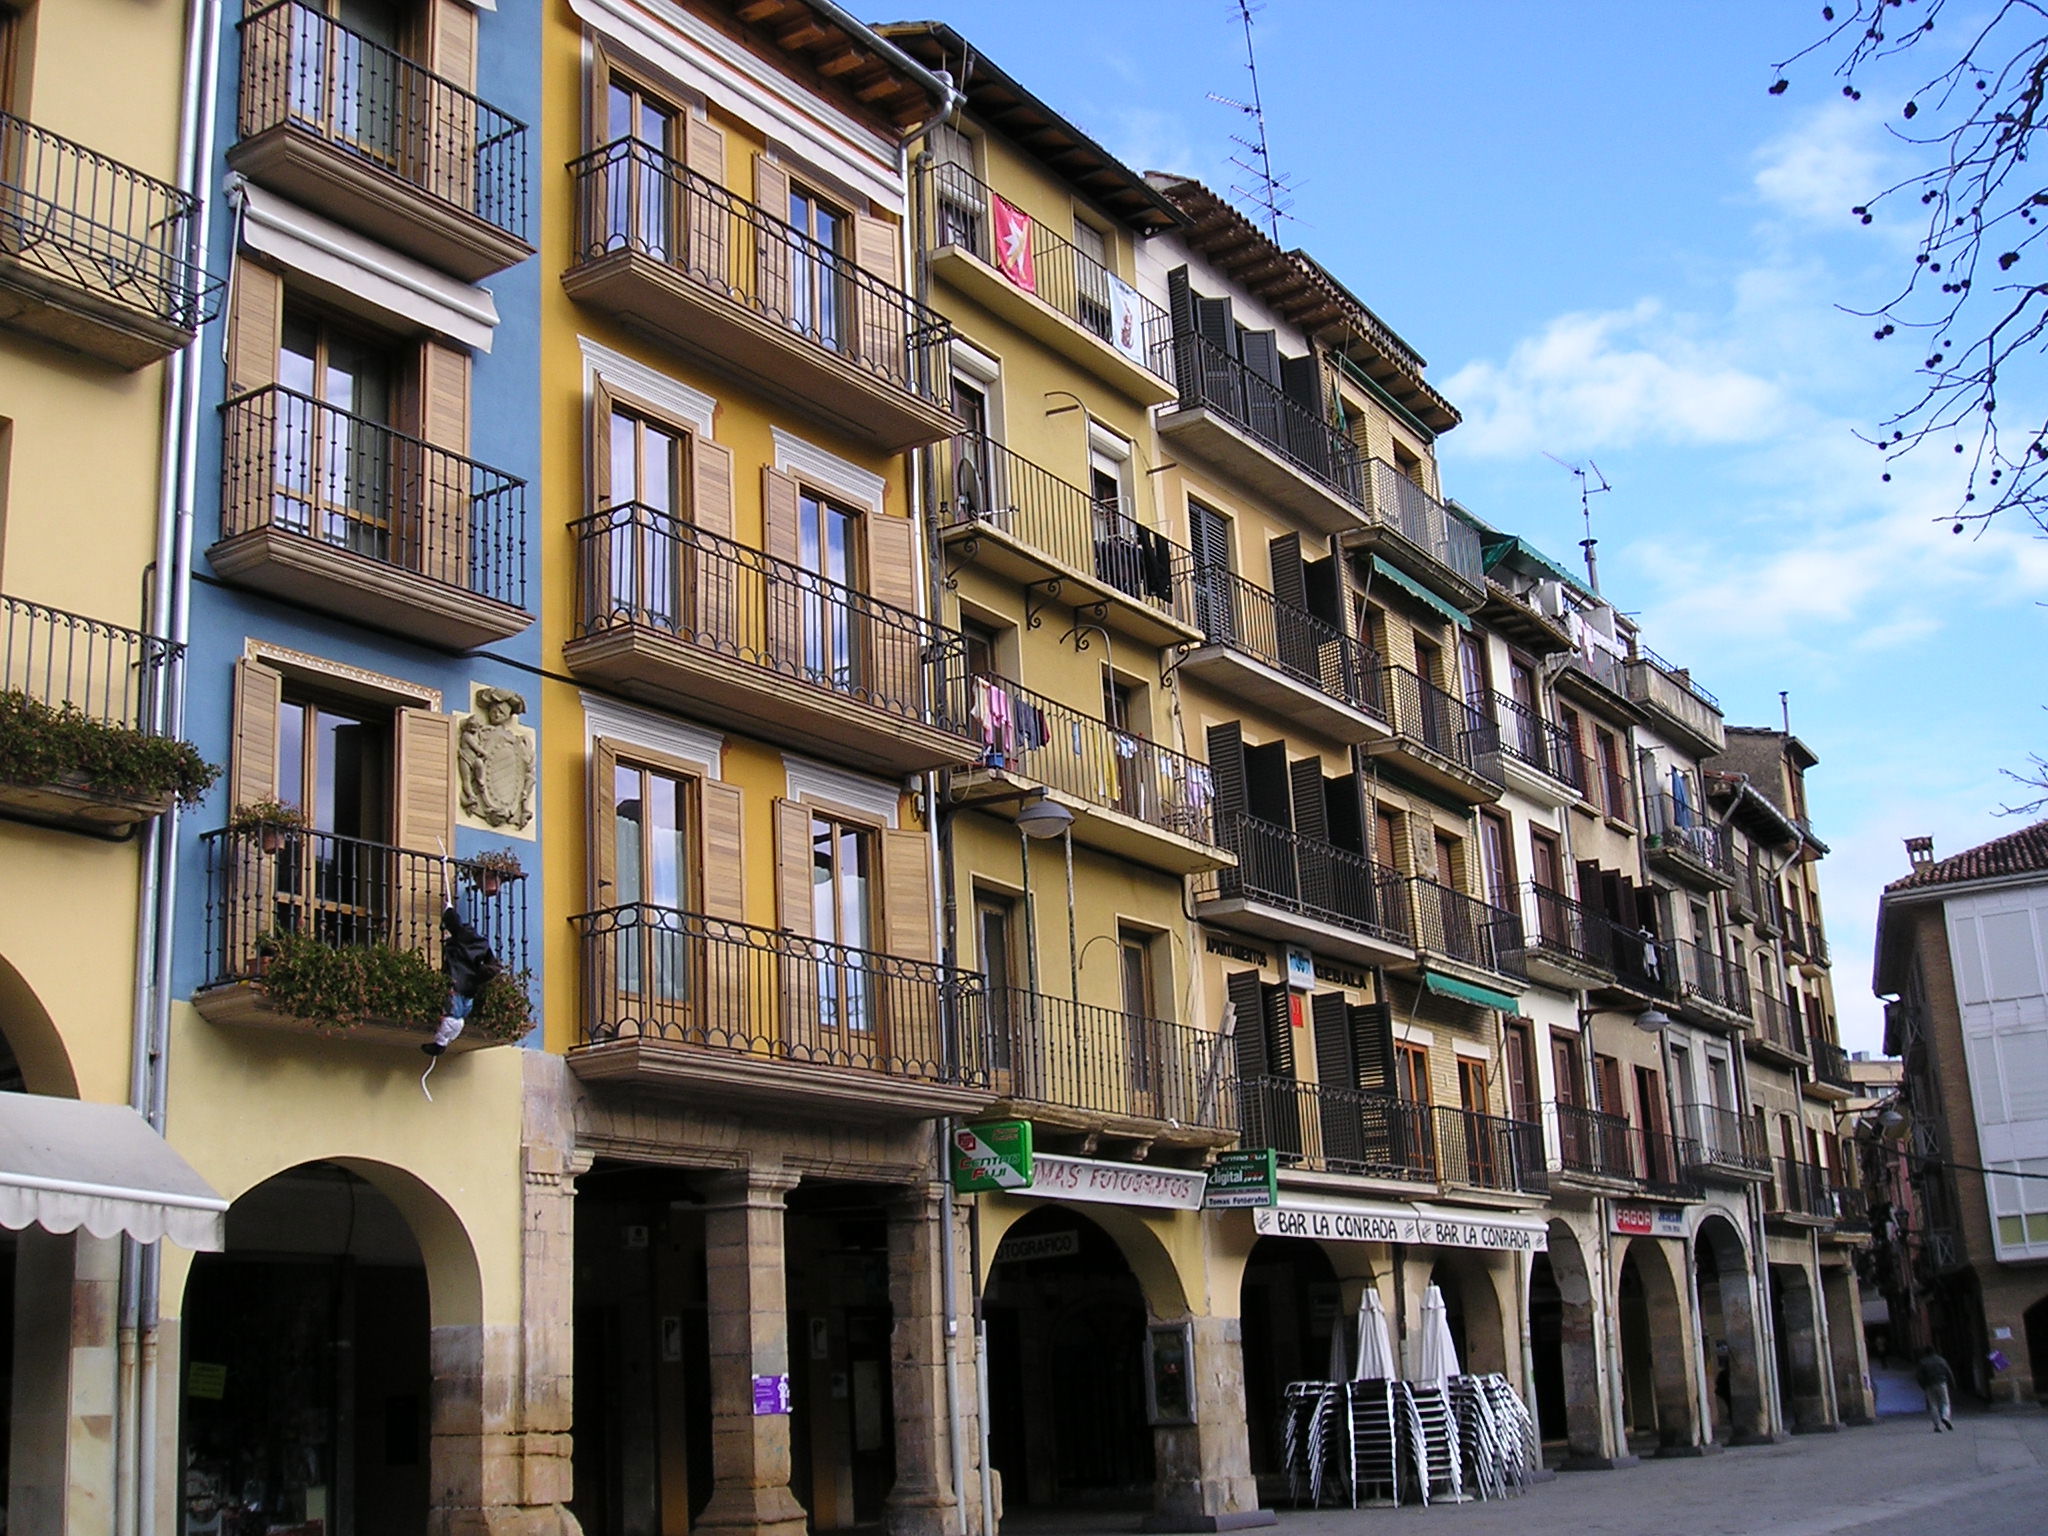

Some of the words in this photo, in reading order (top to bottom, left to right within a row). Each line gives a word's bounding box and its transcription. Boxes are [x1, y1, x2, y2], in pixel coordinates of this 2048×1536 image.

[1206, 936, 1267, 968] APARTAMENTOS
[972, 1168, 1007, 1180] FUJI
[1208, 1168, 1242, 1186] digital
[1277, 1211, 1308, 1235] BAR
[1312, 1214, 1330, 1236] LA
[1335, 1215, 1398, 1240] CONRADA
[1616, 1208, 1652, 1226] FAGOR
[1435, 1223, 1460, 1244] BAR
[1463, 1225, 1477, 1245] LA
[1481, 1226, 1531, 1249] CONRADA
